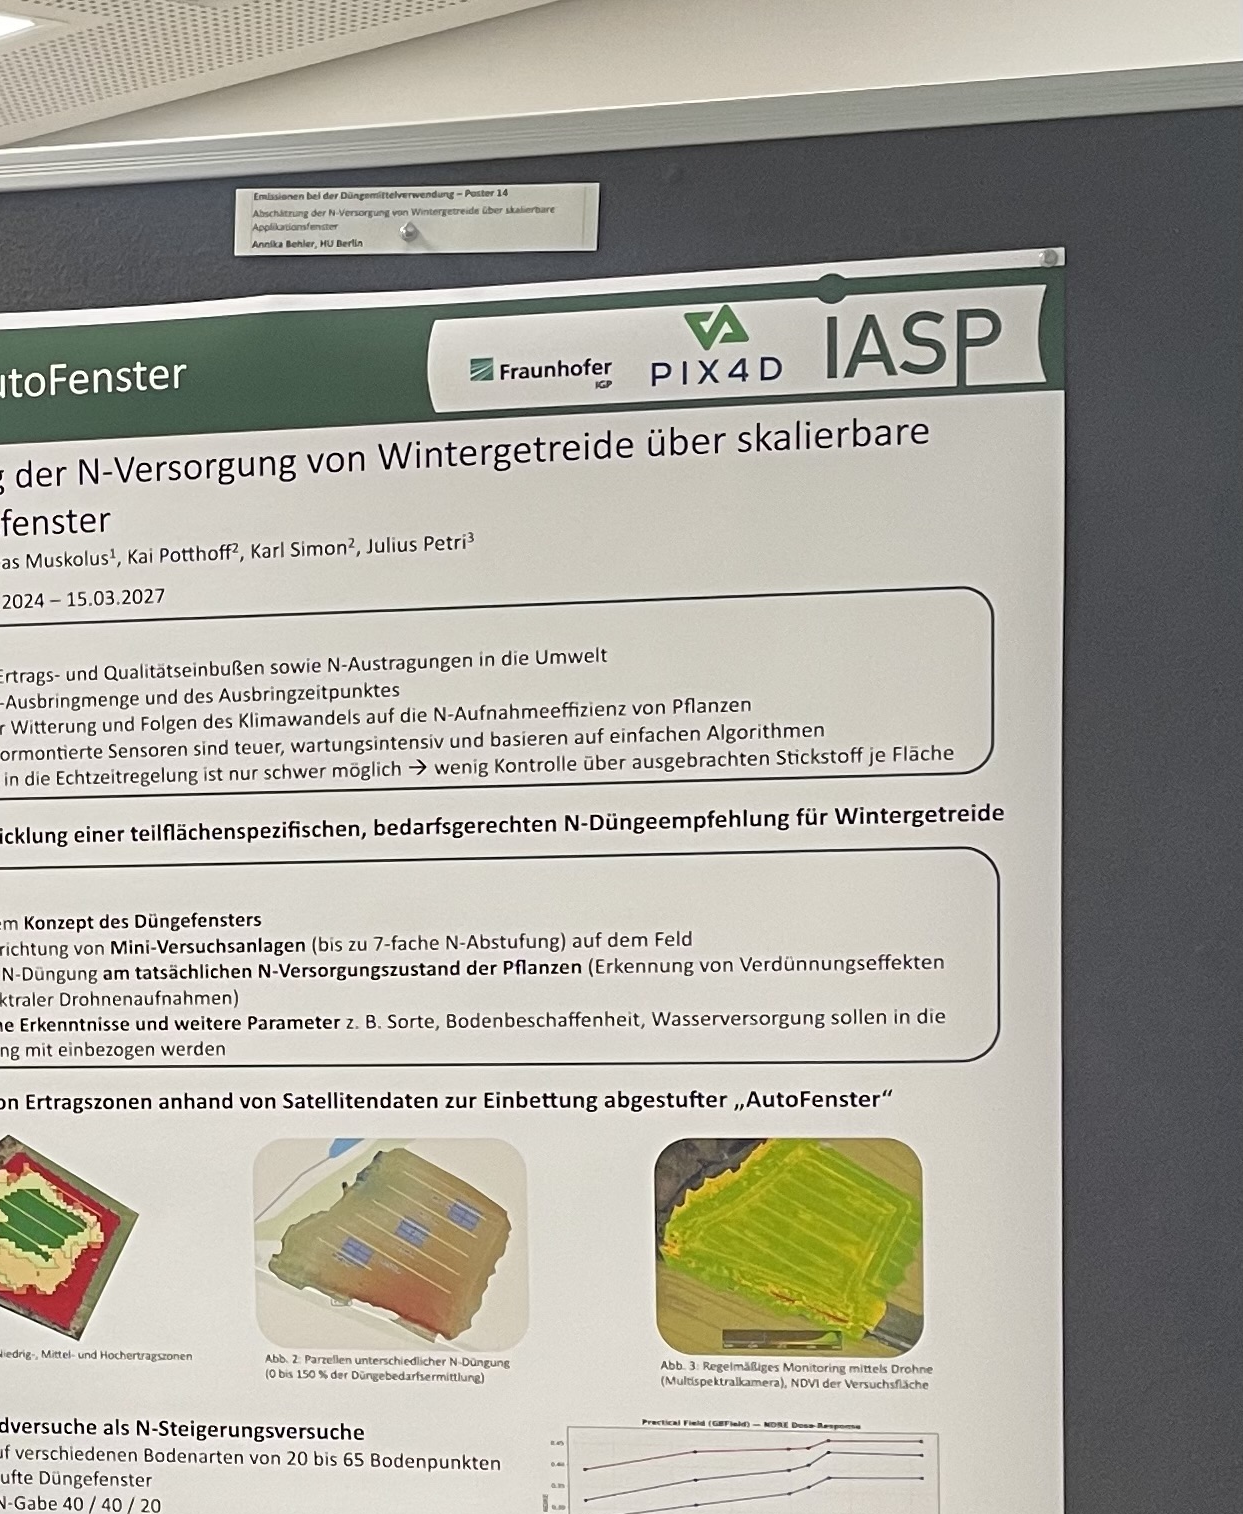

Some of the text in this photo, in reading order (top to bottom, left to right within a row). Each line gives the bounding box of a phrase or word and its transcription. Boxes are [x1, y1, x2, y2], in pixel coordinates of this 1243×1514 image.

[254, 192, 305, 201] Emissionen
[323, 191, 339, 201] der
[497, 189, 508, 197] 14
[311, 209, 325, 217] der
[252, 240, 283, 248] Annika
[319, 240, 334, 248] HU
[336, 239, 363, 248] Berlin
[827, 309, 1002, 386] IASP
[500, 358, 612, 381] Fraunhofer
[651, 356, 783, 387] PIX4D
[15, 459, 68, 489] der
[78, 454, 297, 486] N-Versorgung
[306, 450, 365, 474] von
[377, 429, 634, 472] Wintergetreide
[647, 426, 727, 457] über
[737, 417, 930, 453] skalierbare
[66, 587, 166, 608] 15.03.2027
[66, 664, 98, 682] und
[103, 659, 265, 682] Qualitätseinbußen
[270, 657, 322, 675] sowie
[327, 655, 473, 674] N-Austragungen
[479, 650, 496, 667] in
[500, 649, 530, 667] die
[535, 646, 608, 666] Umwelt
[145, 688, 178, 706] und
[183, 687, 214, 705] des
[218, 681, 400, 705] Ausbringzeitpunktes
[73, 825, 125, 843] einer
[129, 819, 367, 844] teilflächenspezifischen,
[373, 814, 557, 839] bedarfsgerechten
[564, 808, 790, 835] N-Düngeempfehlung
[795, 807, 829, 827] für
[834, 802, 1005, 828] Wintergetreide
[24, 915, 95, 934] Konzept
[98, 913, 129, 930] des
[134, 911, 262, 932] Düngefensters
[59, 988, 239, 1009] Drohnenaufnahmen)
[25, 1093, 152, 1115] Ertragszonen
[158, 1091, 234, 1110] anhand
[238, 1096, 277, 1110] von
[282, 1091, 439, 1110] Satellitendaten
[444, 1096, 478, 1109] zur
[483, 1090, 599, 1113] Einbettung
[604, 1089, 729, 1113] abgestufter
[733, 1088, 893, 1112] „AutoFenster“
[102, 1418, 130, 1436] als
[136, 1419, 365, 1443] N-Steigerungsversuche
[38, 1470, 153, 1490] Düngefenster
